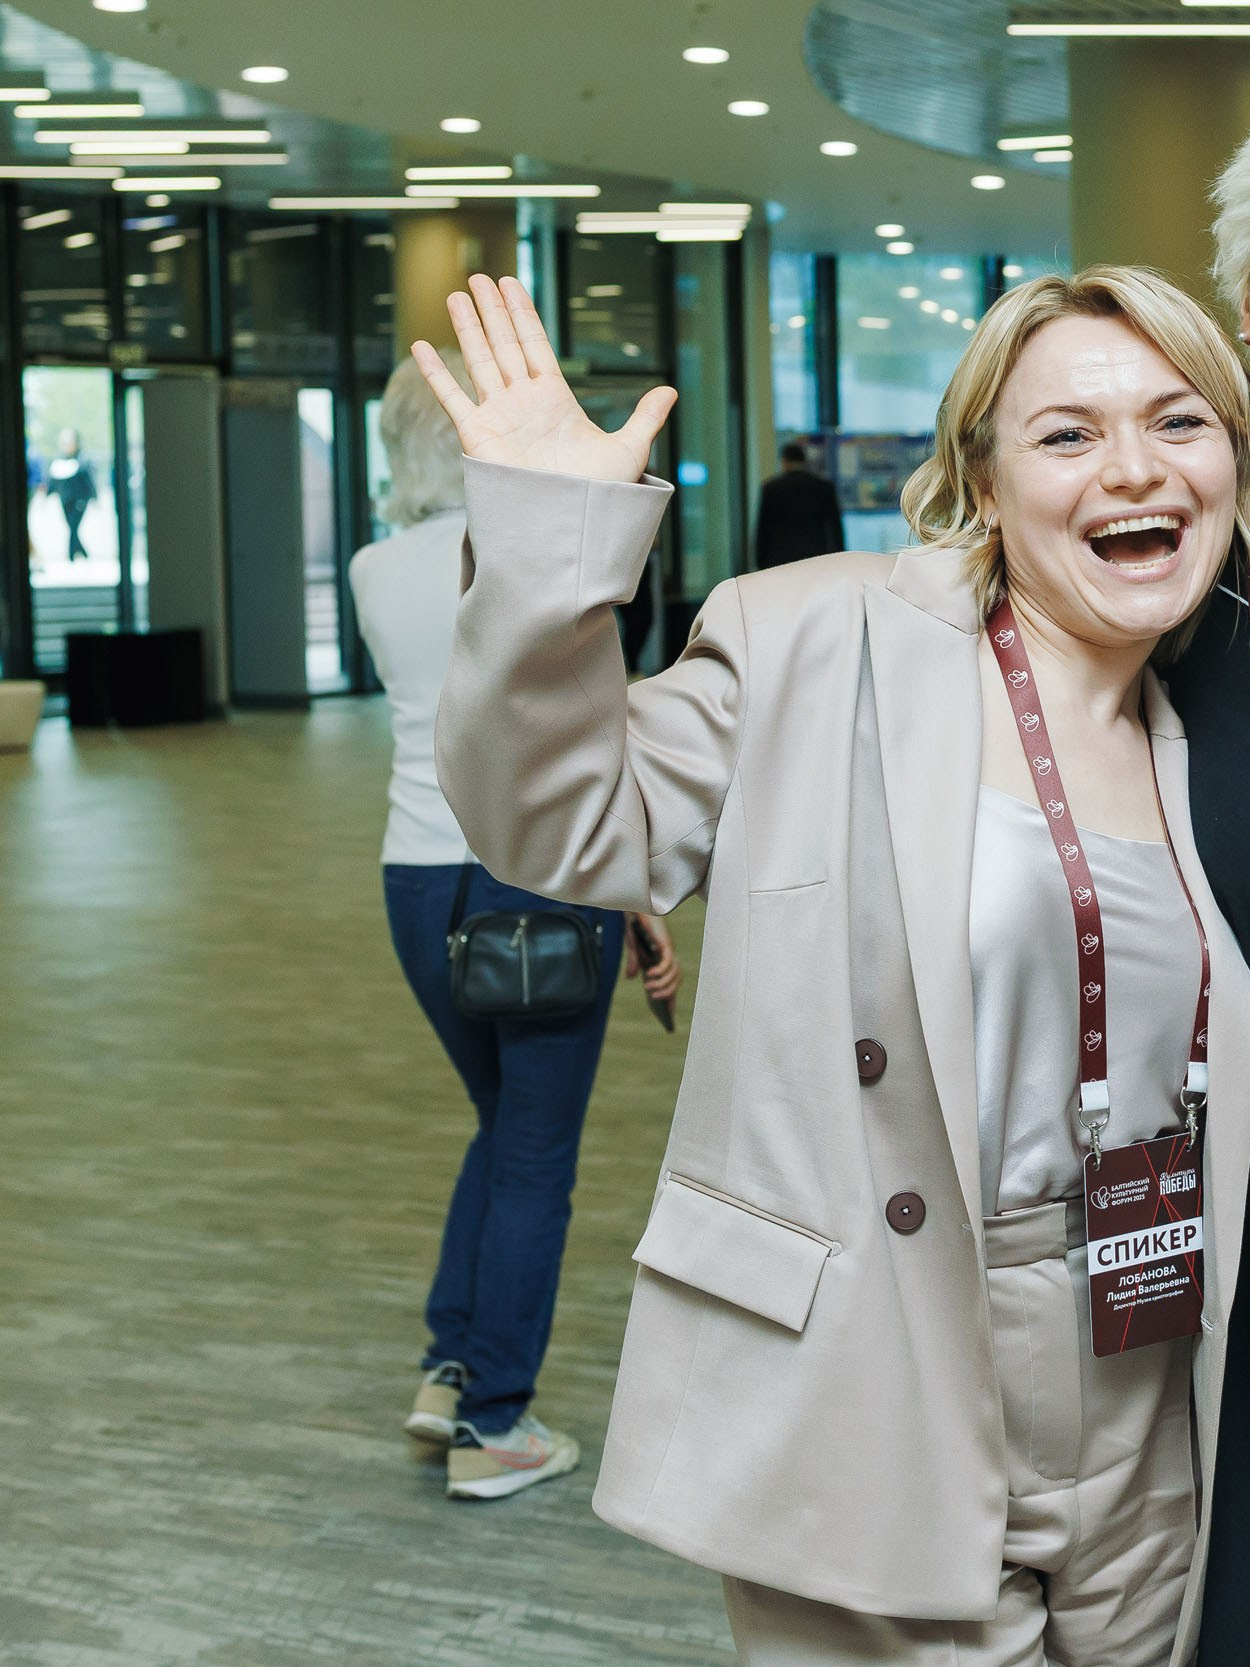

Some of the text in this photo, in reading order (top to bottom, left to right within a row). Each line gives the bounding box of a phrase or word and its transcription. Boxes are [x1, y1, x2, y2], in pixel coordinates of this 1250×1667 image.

[1111, 1177, 1150, 1192] БАЛТИЙСКИЙ
[1111, 1185, 1149, 1199] КУЛЬТУРНЫЙ
[1160, 1173, 1196, 1196] ПОБЕДЫ
[1111, 1194, 1146, 1206] ФОРУМ 2025
[1097, 1225, 1197, 1266] СПИКЕР
[1118, 1265, 1177, 1287] ЛОБАНОВА
[1106, 1276, 1190, 1302] Лидия Валерьевна
